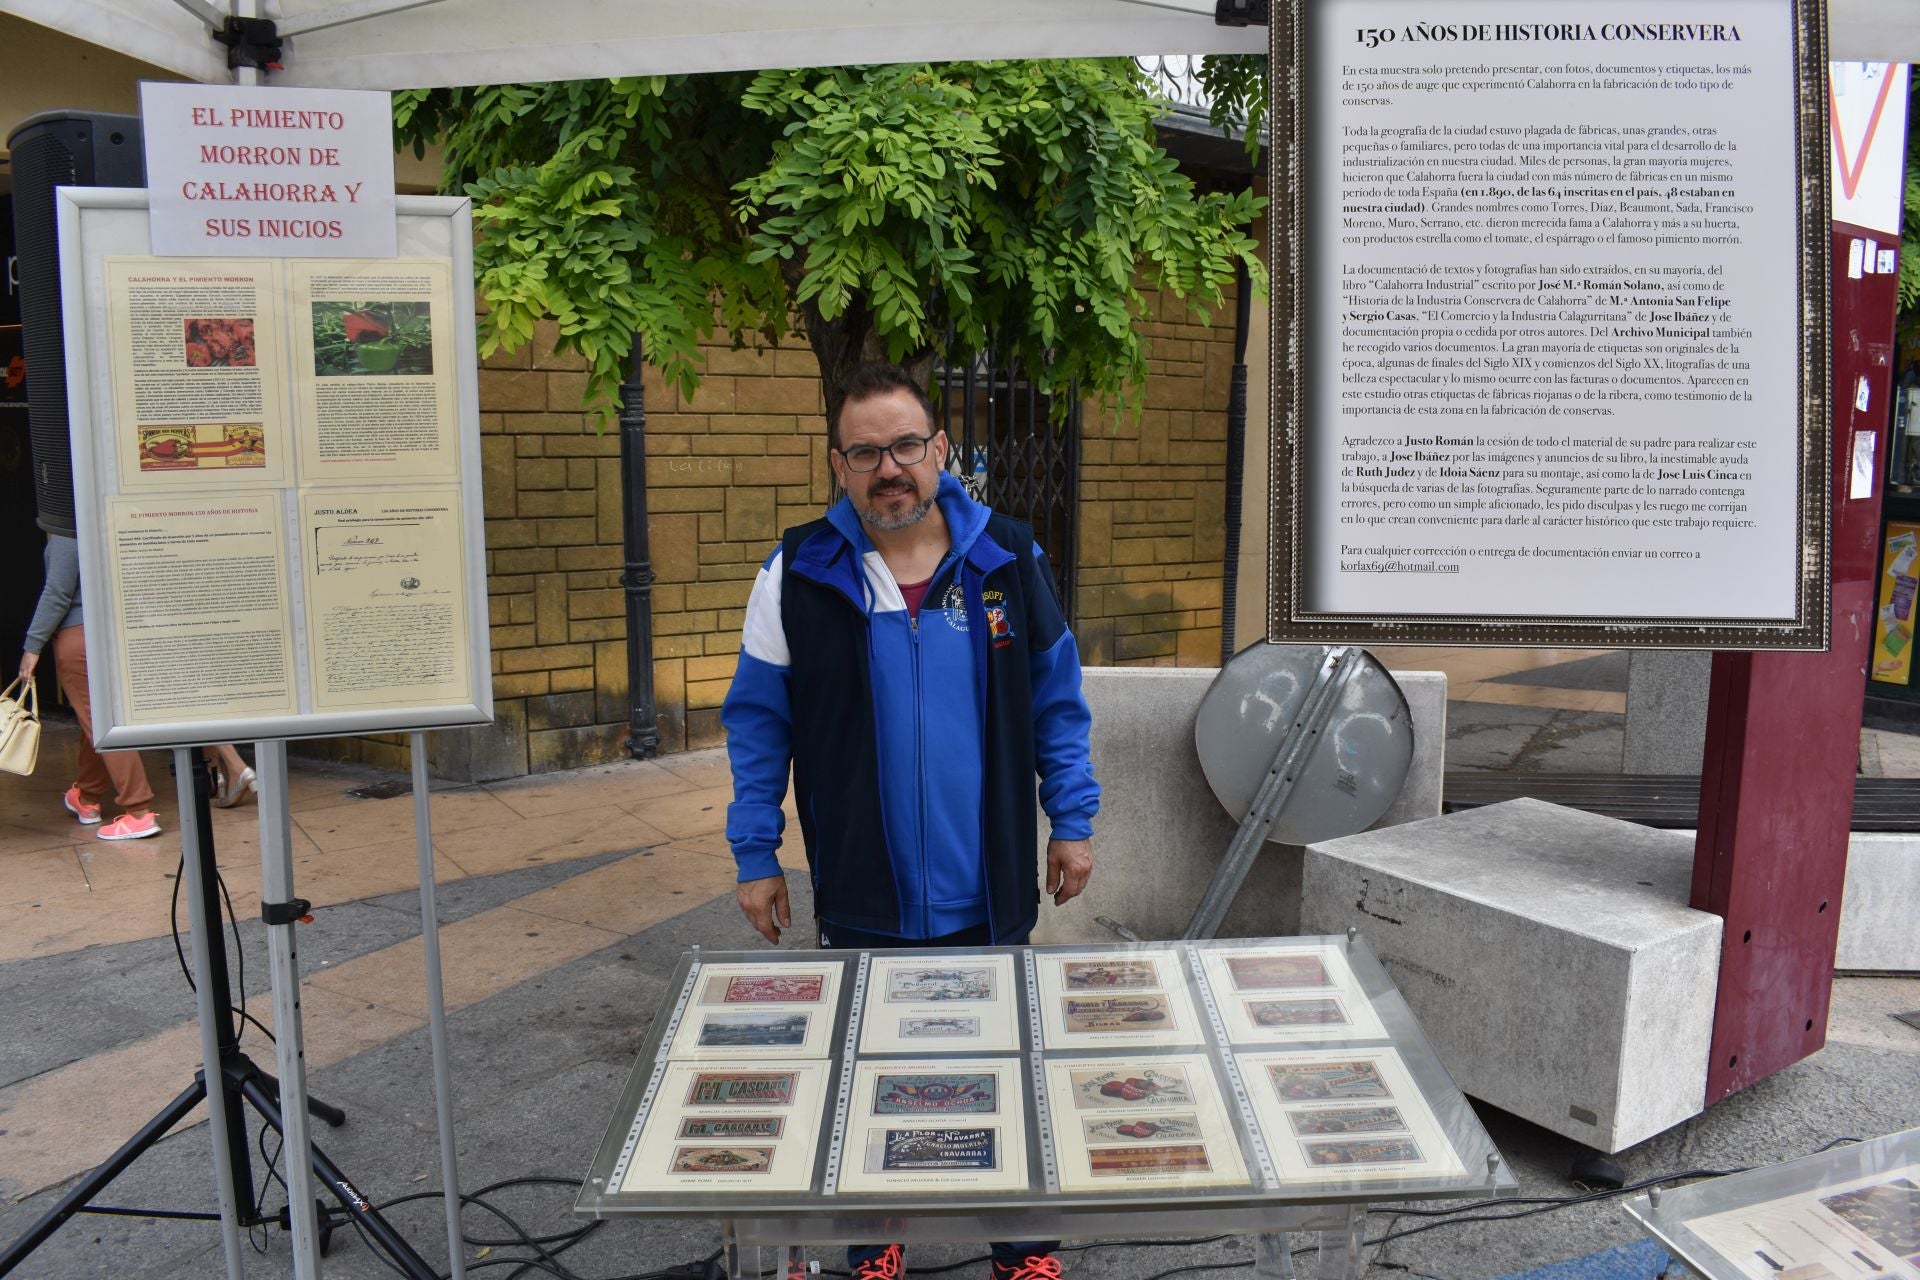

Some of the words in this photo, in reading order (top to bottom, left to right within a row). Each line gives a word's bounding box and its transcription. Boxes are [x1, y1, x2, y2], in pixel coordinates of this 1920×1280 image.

[1356, 28, 1396, 48] 150
[1401, 21, 1458, 42] AÑOS
[1462, 24, 1491, 41] DE
[1495, 24, 1597, 41] HISTORIA
[1601, 24, 1741, 41] CONSERVERA
[1343, 65, 1356, 75] En
[1422, 64, 1443, 74] solo
[1445, 64, 1490, 77] pretendo
[1492, 66, 1542, 77] presentar,
[1565, 64, 1593, 74] fotos,
[1595, 63, 1656, 73] documentos
[1658, 67, 1662, 76] y
[1666, 64, 1713, 76] etiquetas,
[1716, 64, 1730, 74] los
[1733, 65, 1752, 74] más
[1342, 81, 1354, 90] de
[1357, 83, 1374, 92] 150
[1376, 81, 1399, 90] años
[1401, 80, 1413, 89] de
[1416, 82, 1439, 92] auge
[1441, 82, 1460, 92] que
[1462, 79, 1525, 92] experimentó
[1527, 79, 1576, 89] Calahorra
[1593, 79, 1601, 88] la
[1603, 79, 1658, 89] fabricación
[1660, 79, 1672, 88] de
[1675, 79, 1697, 89] todo
[1700, 80, 1719, 92] tipo
[1721, 79, 1733, 89] de
[192, 107, 223, 128] EL
[230, 108, 344, 130] PIMIENTO
[1343, 126, 1368, 136] Toda
[1371, 126, 1379, 136] la
[1380, 125, 1427, 138] geografía
[1429, 125, 1441, 135] de
[1444, 125, 1452, 135] la
[1454, 125, 1487, 135] ciudad
[1524, 125, 1562, 138] plagada
[1564, 125, 1576, 135] de
[1579, 125, 1620, 135] fábricas,
[1647, 125, 1690, 138] grandes,
[200, 144, 301, 165] MORRON
[309, 147, 341, 166] DE
[182, 181, 337, 203] CALAHORRA
[344, 181, 363, 204] Y
[1343, 187, 1381, 200] período
[1384, 187, 1396, 197] de
[1398, 187, 1420, 197] toda
[1422, 186, 1458, 200] España
[1461, 187, 1478, 198] (en
[1481, 187, 1515, 199] 1.890,
[1517, 186, 1530, 196] de
[1532, 186, 1546, 197] las
[1548, 187, 1561, 199] 64
[1564, 186, 1609, 197] inscritas
[1625, 186, 1635, 197] el
[1637, 187, 1662, 200] país,
[1664, 187, 1677, 200] 48
[1679, 186, 1720, 198] estaban
[1343, 205, 1383, 213] nuestra
[1431, 202, 1473, 212] Grandes
[1476, 202, 1519, 212] nombres
[1551, 202, 1588, 213] Torres,
[1591, 202, 1617, 213] Díaz,
[1620, 202, 1673, 213] Beaumont,
[1676, 202, 1702, 213] Sada,
[1705, 202, 1753, 213] Francisco
[205, 218, 251, 237] SUS
[258, 219, 343, 238] INICIOS
[1343, 280, 1366, 290] libro
[1482, 280, 1516, 290] escrito
[1518, 283, 1536, 293] por
[1537, 279, 1561, 291] José
[1583, 279, 1622, 290] Román
[1623, 280, 1664, 291] Solano,
[1667, 281, 1681, 290] así
[1712, 281, 1725, 291] de
[1341, 545, 1362, 555] Para
[1364, 545, 1411, 558] cualquier
[1413, 546, 1467, 556] corrección
[1478, 549, 1516, 559] entrega
[1518, 546, 1530, 557] de
[1532, 546, 1609, 558] documentación
[1611, 548, 1642, 558] enviar
[1341, 560, 1459, 573] korlax69@hotmail.com
[728, 1080, 787, 1097] CASCANTE
[895, 1096, 938, 1107] ANSELMO
[944, 1097, 976, 1106] OCHOA
[713, 1122, 771, 1133] CASCANTE
